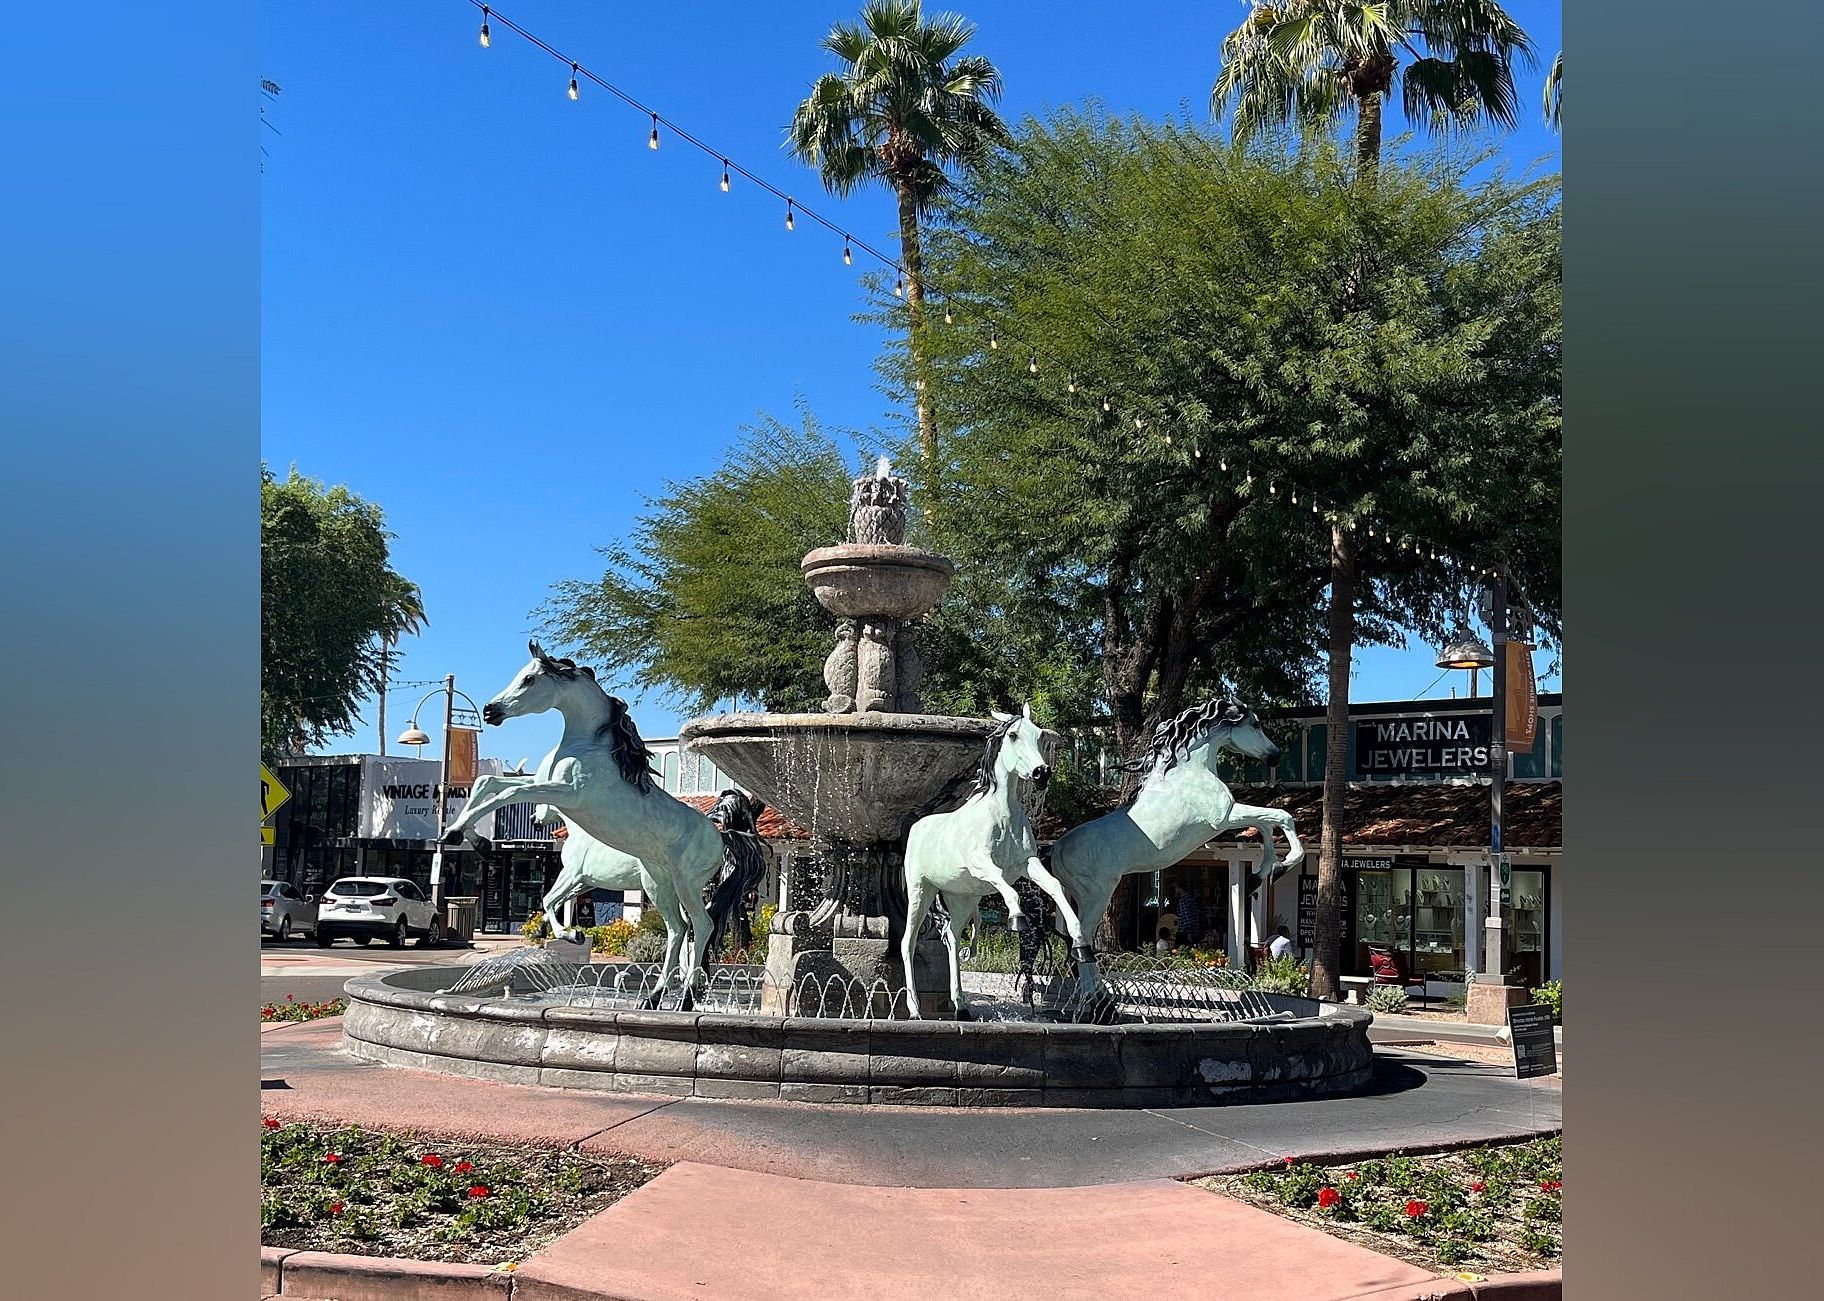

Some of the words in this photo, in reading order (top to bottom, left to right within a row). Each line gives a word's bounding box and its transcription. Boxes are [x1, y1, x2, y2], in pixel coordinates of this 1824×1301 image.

[1525, 706, 1535, 734] SHOPS
[1377, 720, 1470, 742] MARINA
[1361, 746, 1488, 769] JEWELERS
[383, 784, 430, 800] VINTAGE
[405, 805, 430, 816] Luxury
[1350, 859, 1391, 869] JEWELERS
